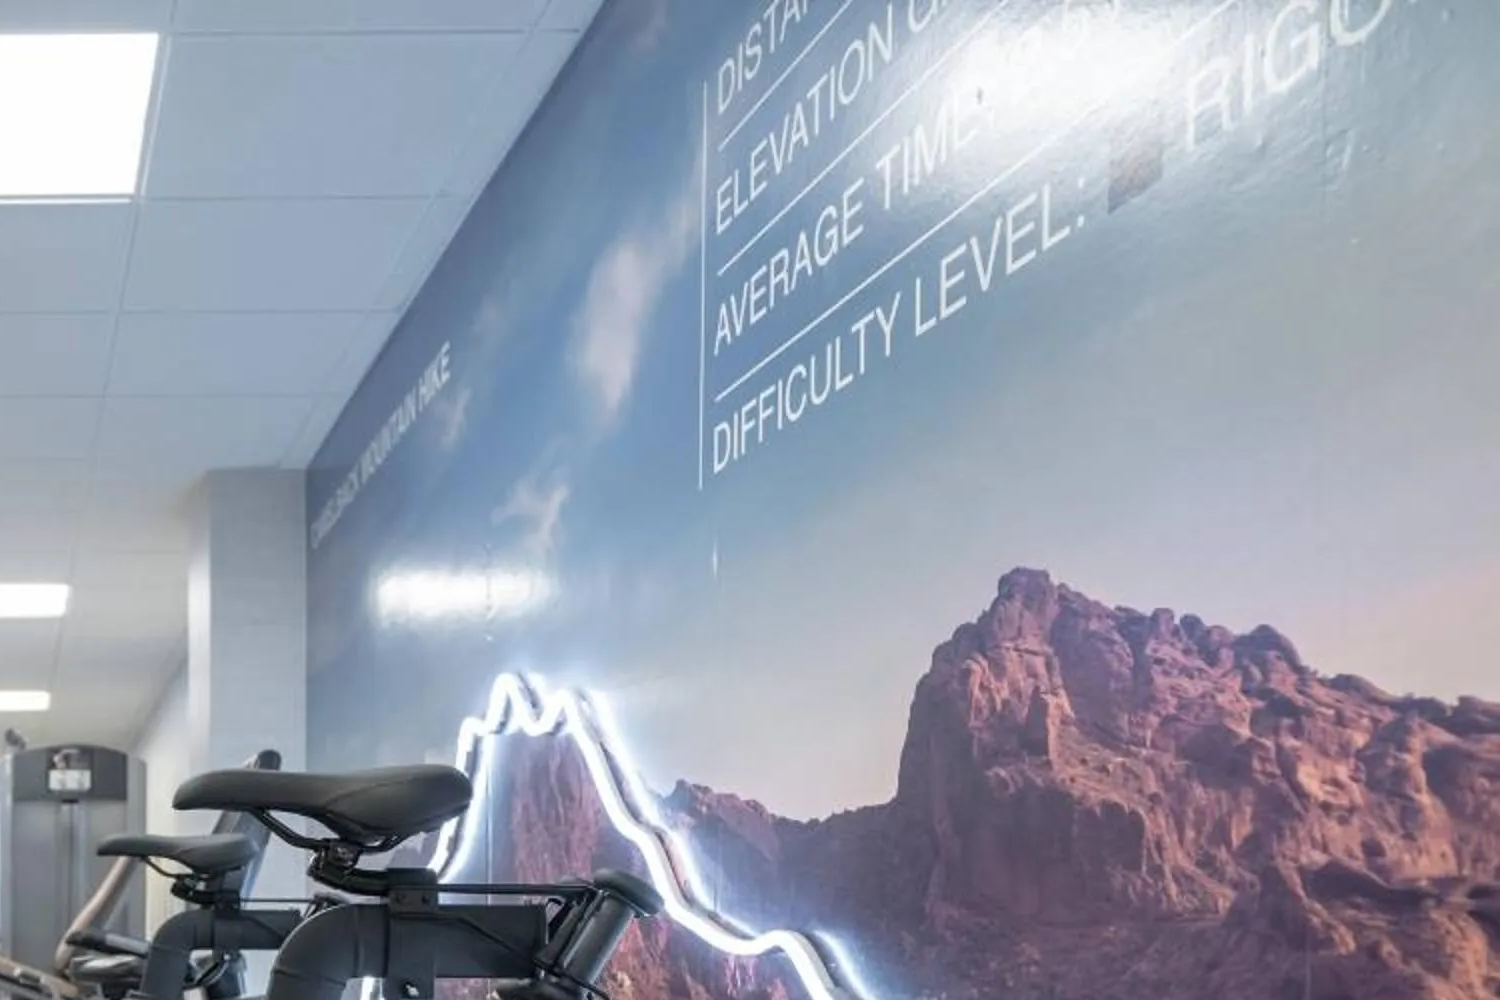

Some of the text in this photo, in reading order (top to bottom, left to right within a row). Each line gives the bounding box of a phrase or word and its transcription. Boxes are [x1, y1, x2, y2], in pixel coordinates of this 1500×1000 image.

[715, 2, 894, 235] ELEVATION
[717, 0, 809, 116] DISTA
[712, 290, 901, 474] DIFFICULTY
[915, 177, 1085, 337] LEVEL:
[713, 175, 865, 357] AVERAGE
